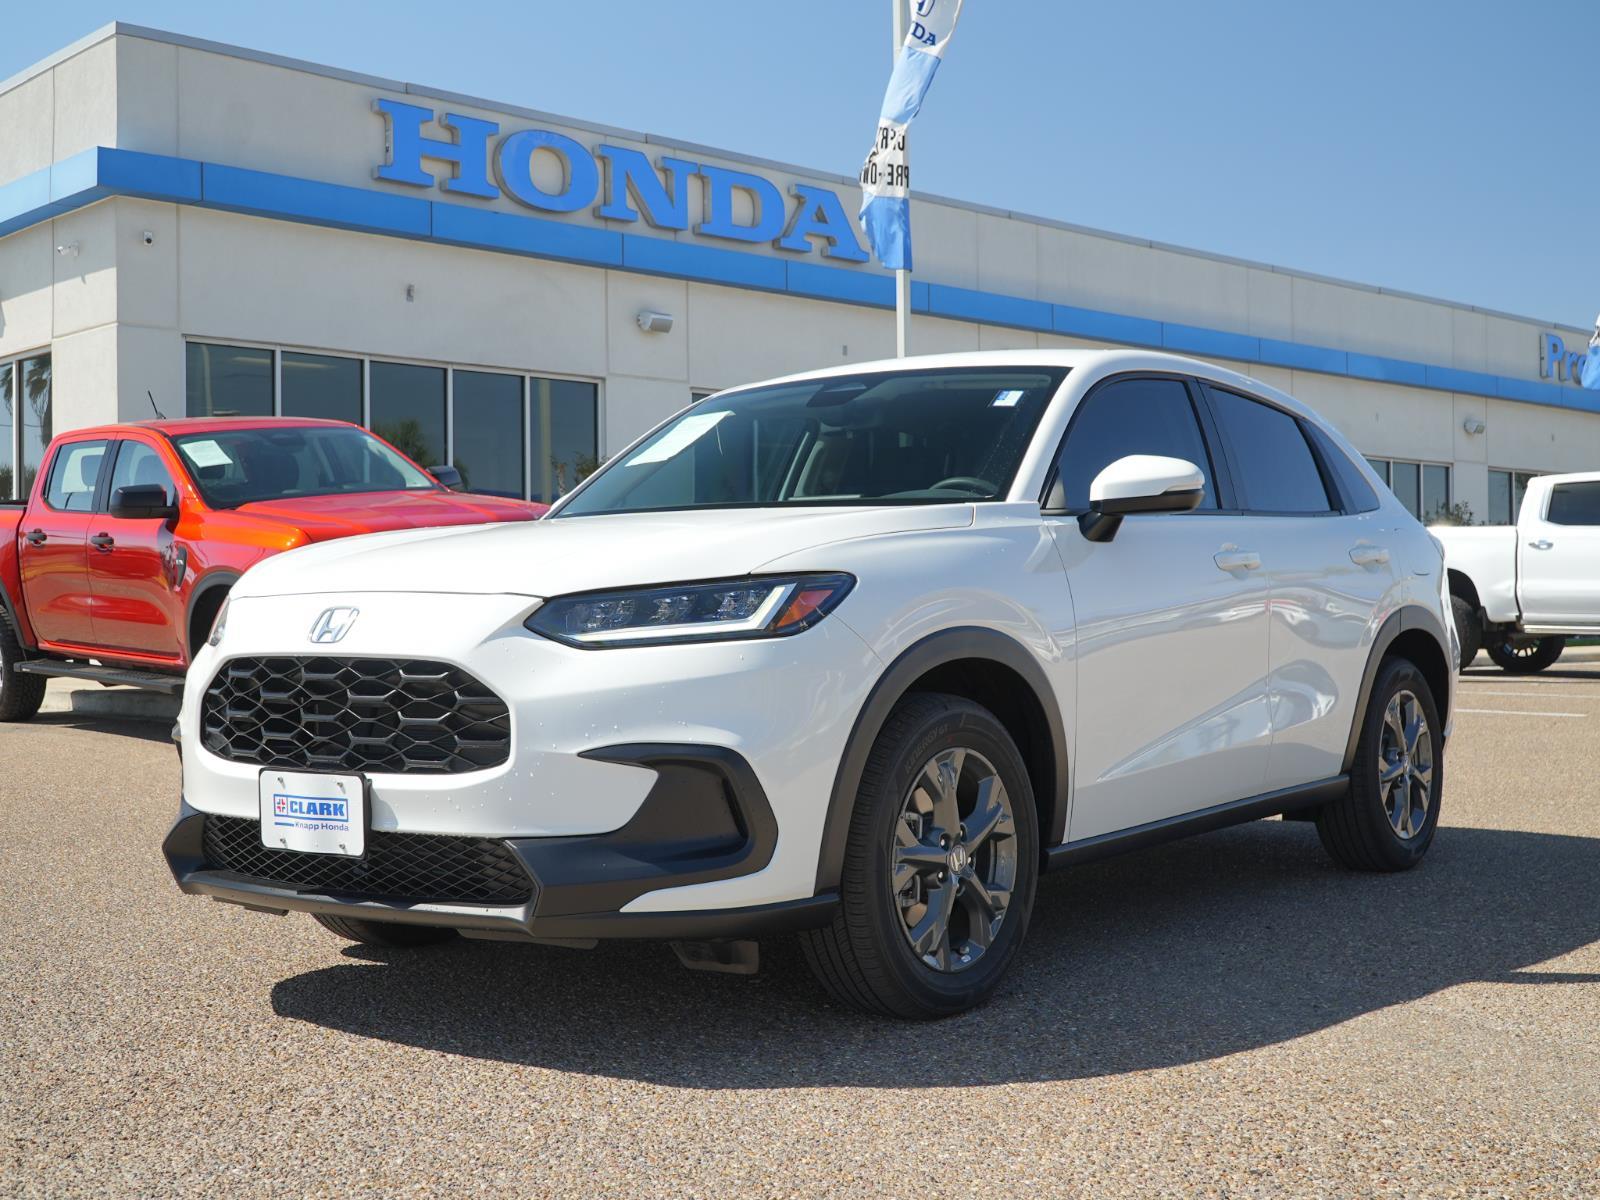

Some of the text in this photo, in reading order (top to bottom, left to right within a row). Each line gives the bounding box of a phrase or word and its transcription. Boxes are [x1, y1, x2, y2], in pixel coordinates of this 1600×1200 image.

[371, 98, 870, 263] HONDA
[289, 800, 345, 816] CLARK
[295, 821, 349, 832] Knapp Honda
